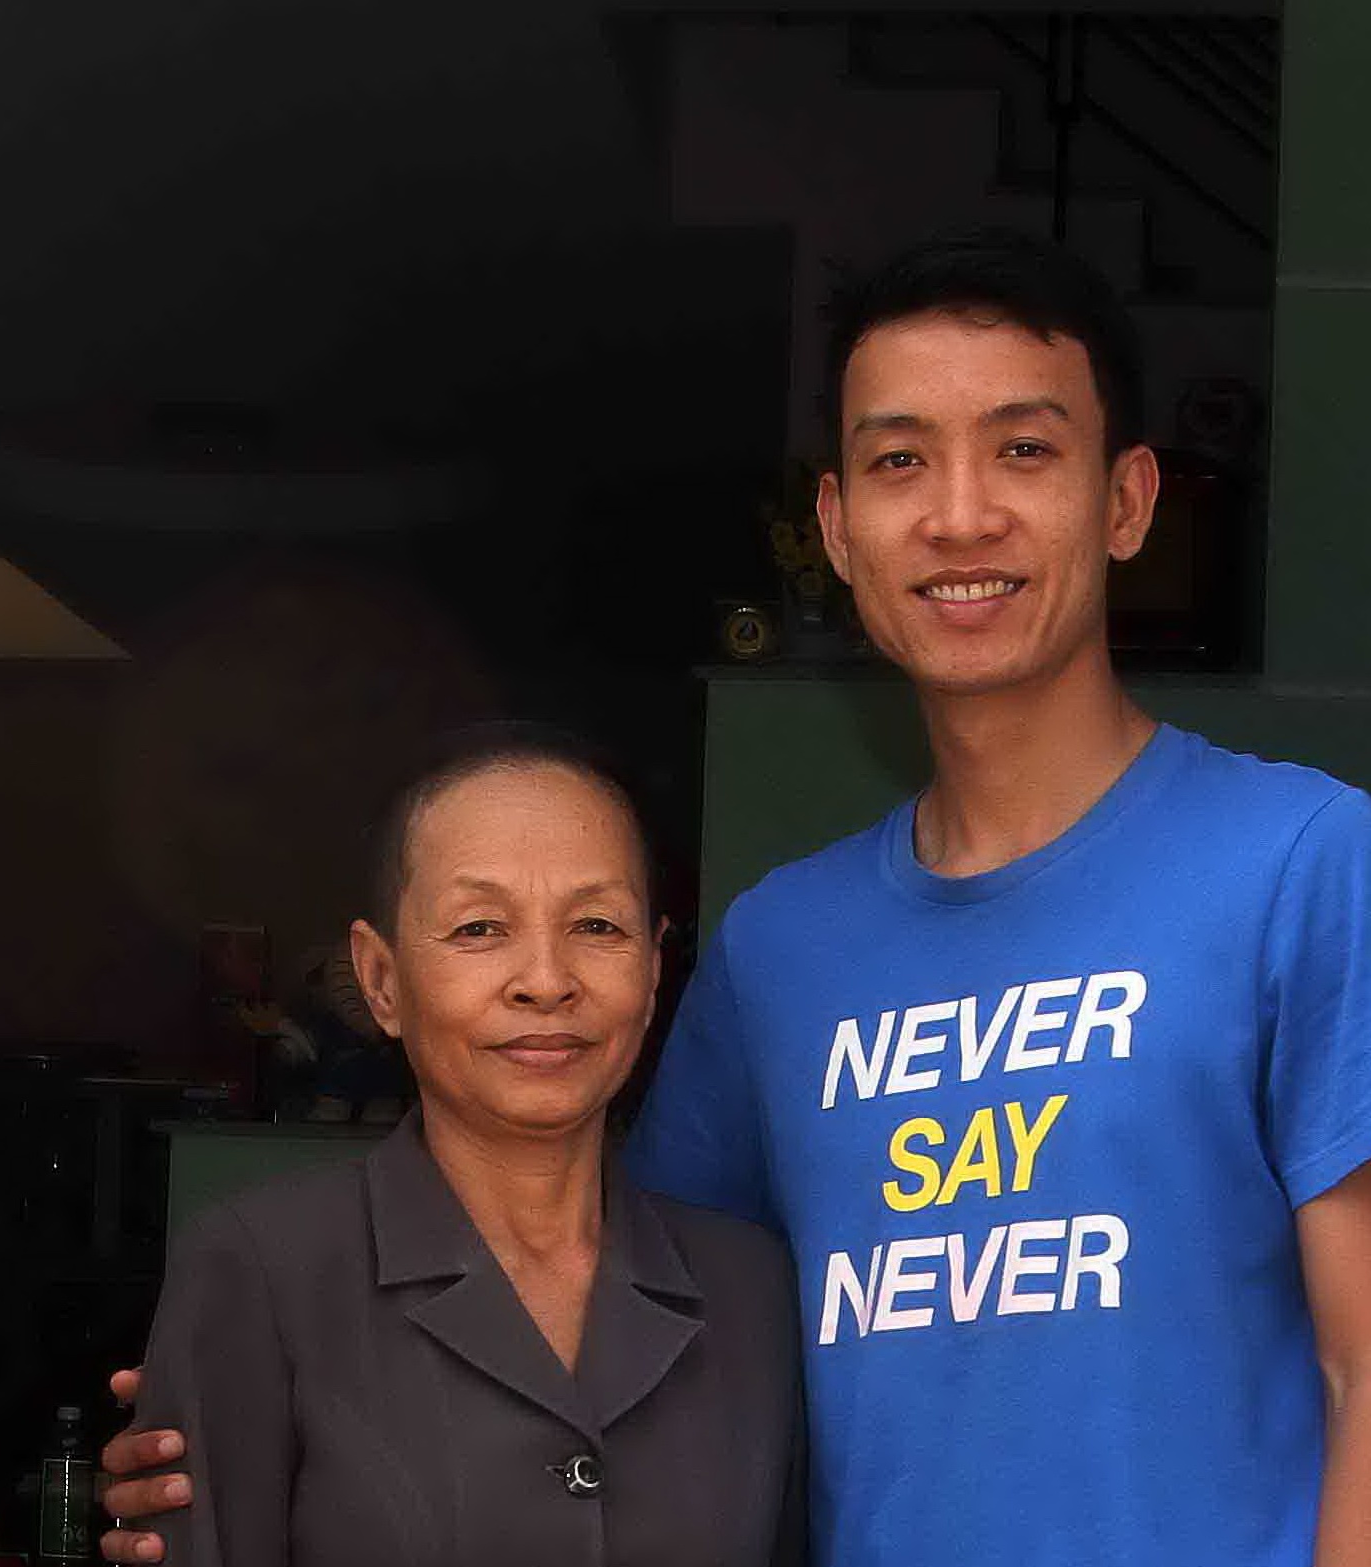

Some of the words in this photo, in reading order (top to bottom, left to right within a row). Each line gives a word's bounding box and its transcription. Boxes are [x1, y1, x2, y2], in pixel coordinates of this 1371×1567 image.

[821, 970, 1147, 1110] NEVER
[883, 1094, 1068, 1212] SAY
[819, 1214, 1130, 1345] NEVER
